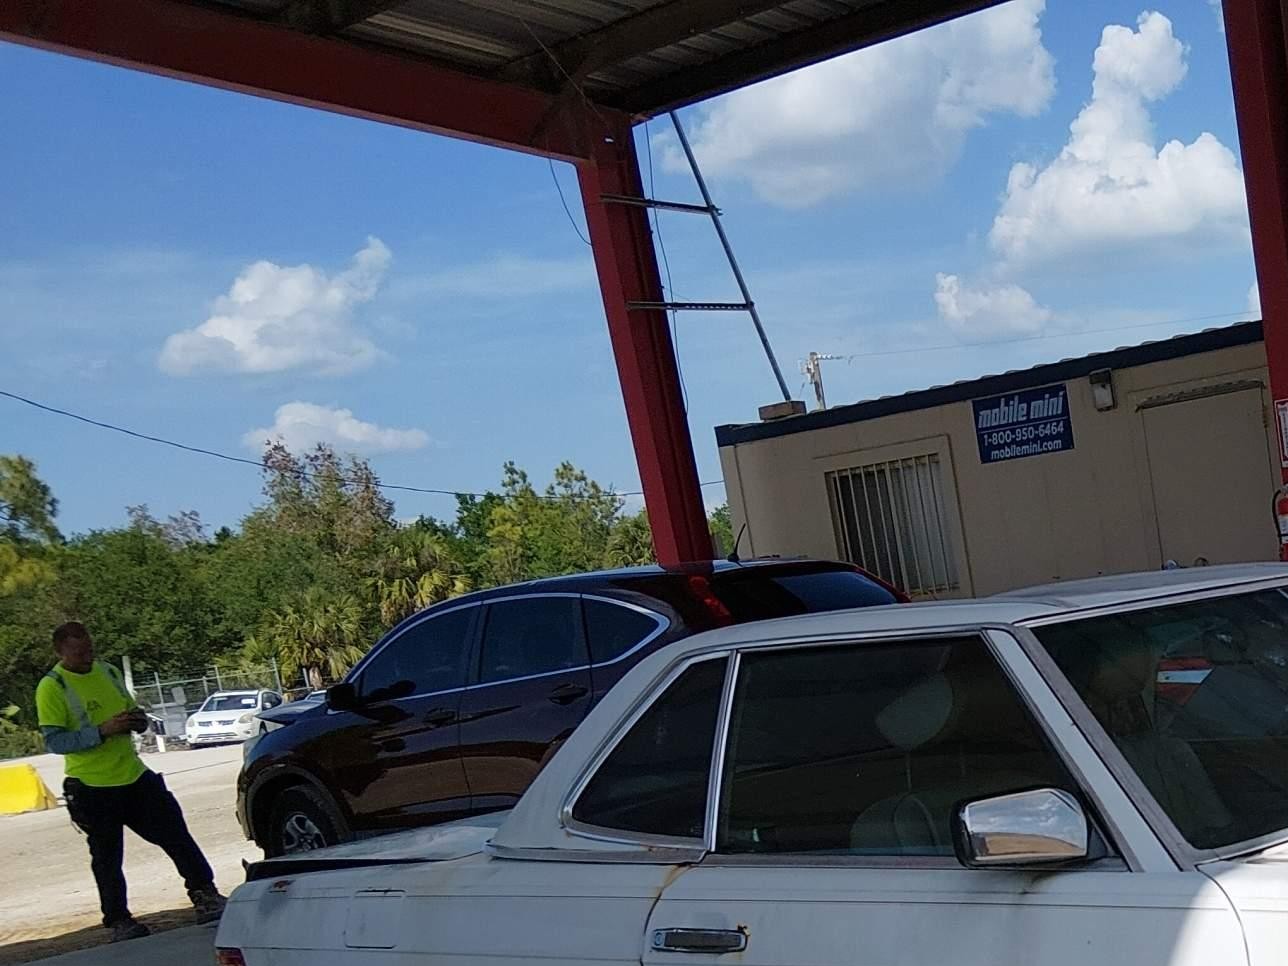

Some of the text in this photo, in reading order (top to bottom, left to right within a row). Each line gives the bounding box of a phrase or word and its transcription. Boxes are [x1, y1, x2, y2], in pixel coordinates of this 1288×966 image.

[978, 391, 1065, 428] mobile mini
[983, 421, 1064, 446] 1-800-950-6464
[991, 439, 1062, 460] mobilemini.com
